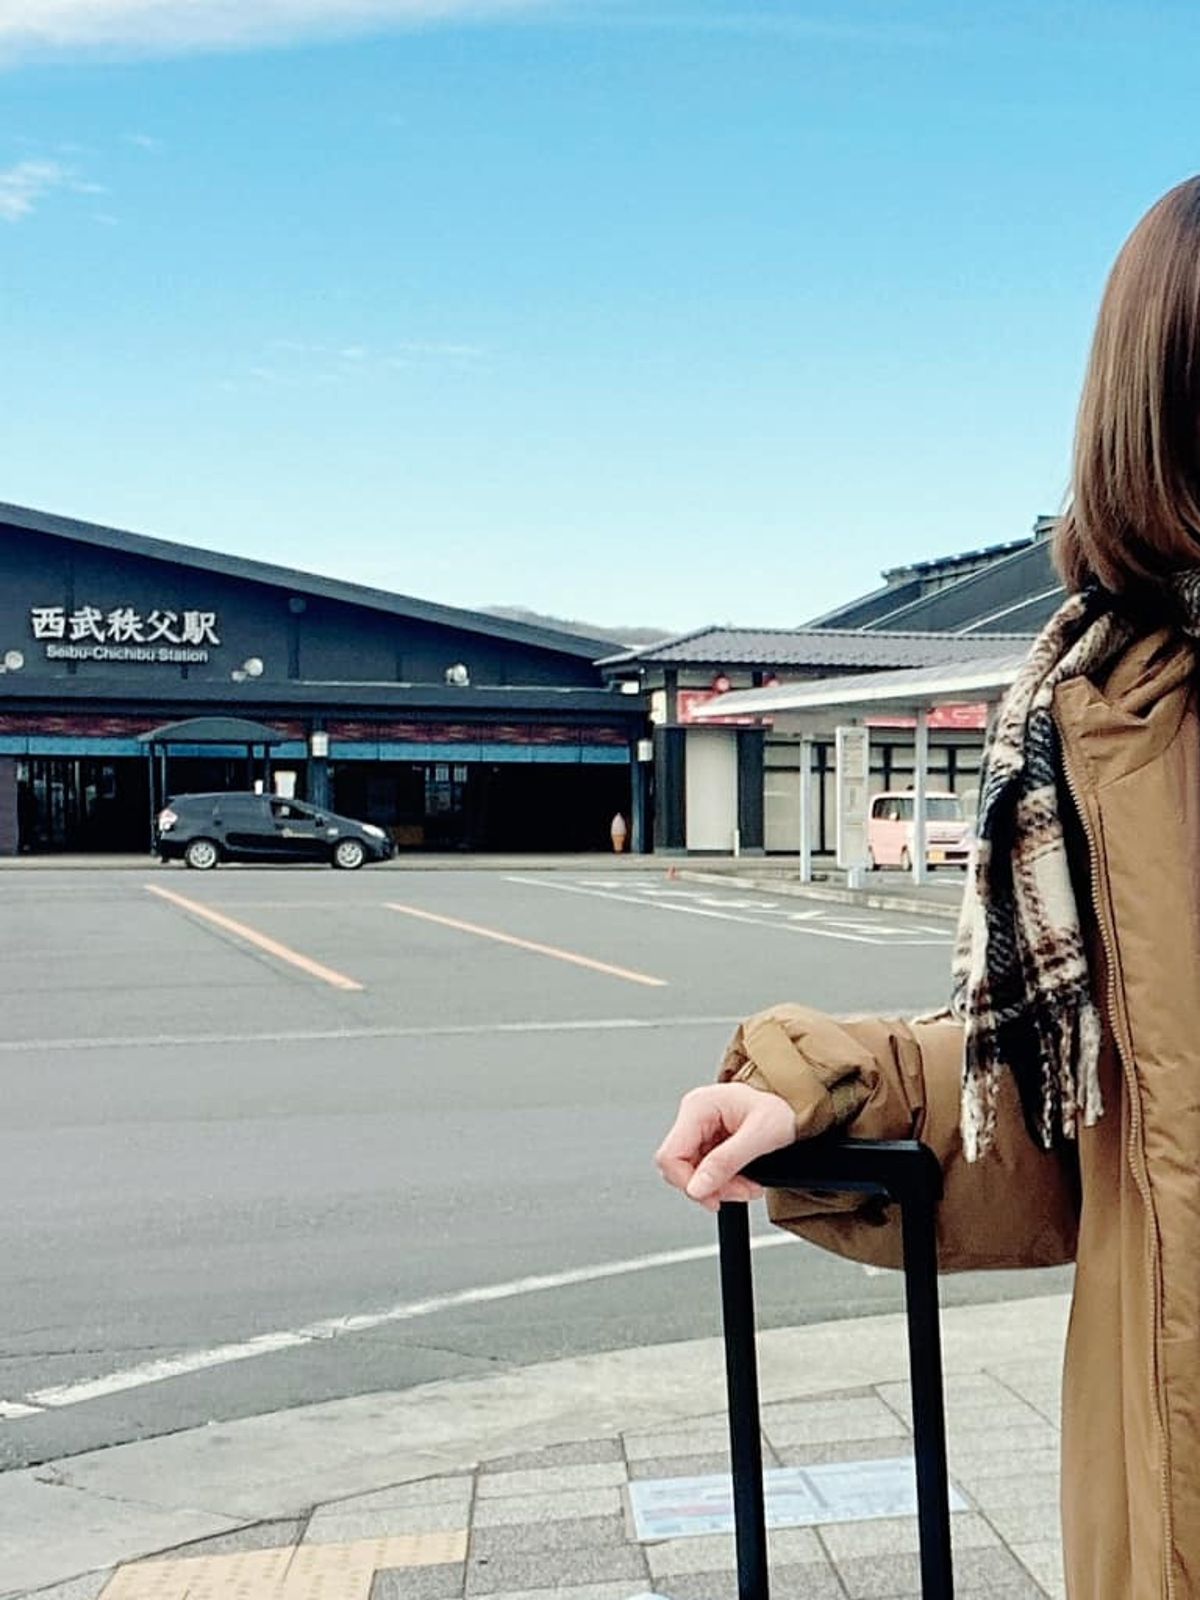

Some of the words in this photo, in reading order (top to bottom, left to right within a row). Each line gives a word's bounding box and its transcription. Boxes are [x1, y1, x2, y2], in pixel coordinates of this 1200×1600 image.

[31, 606, 220, 645] 西武秩父駅
[46, 644, 155, 662] Seibu-Chichibu
[158, 647, 209, 663] Station
